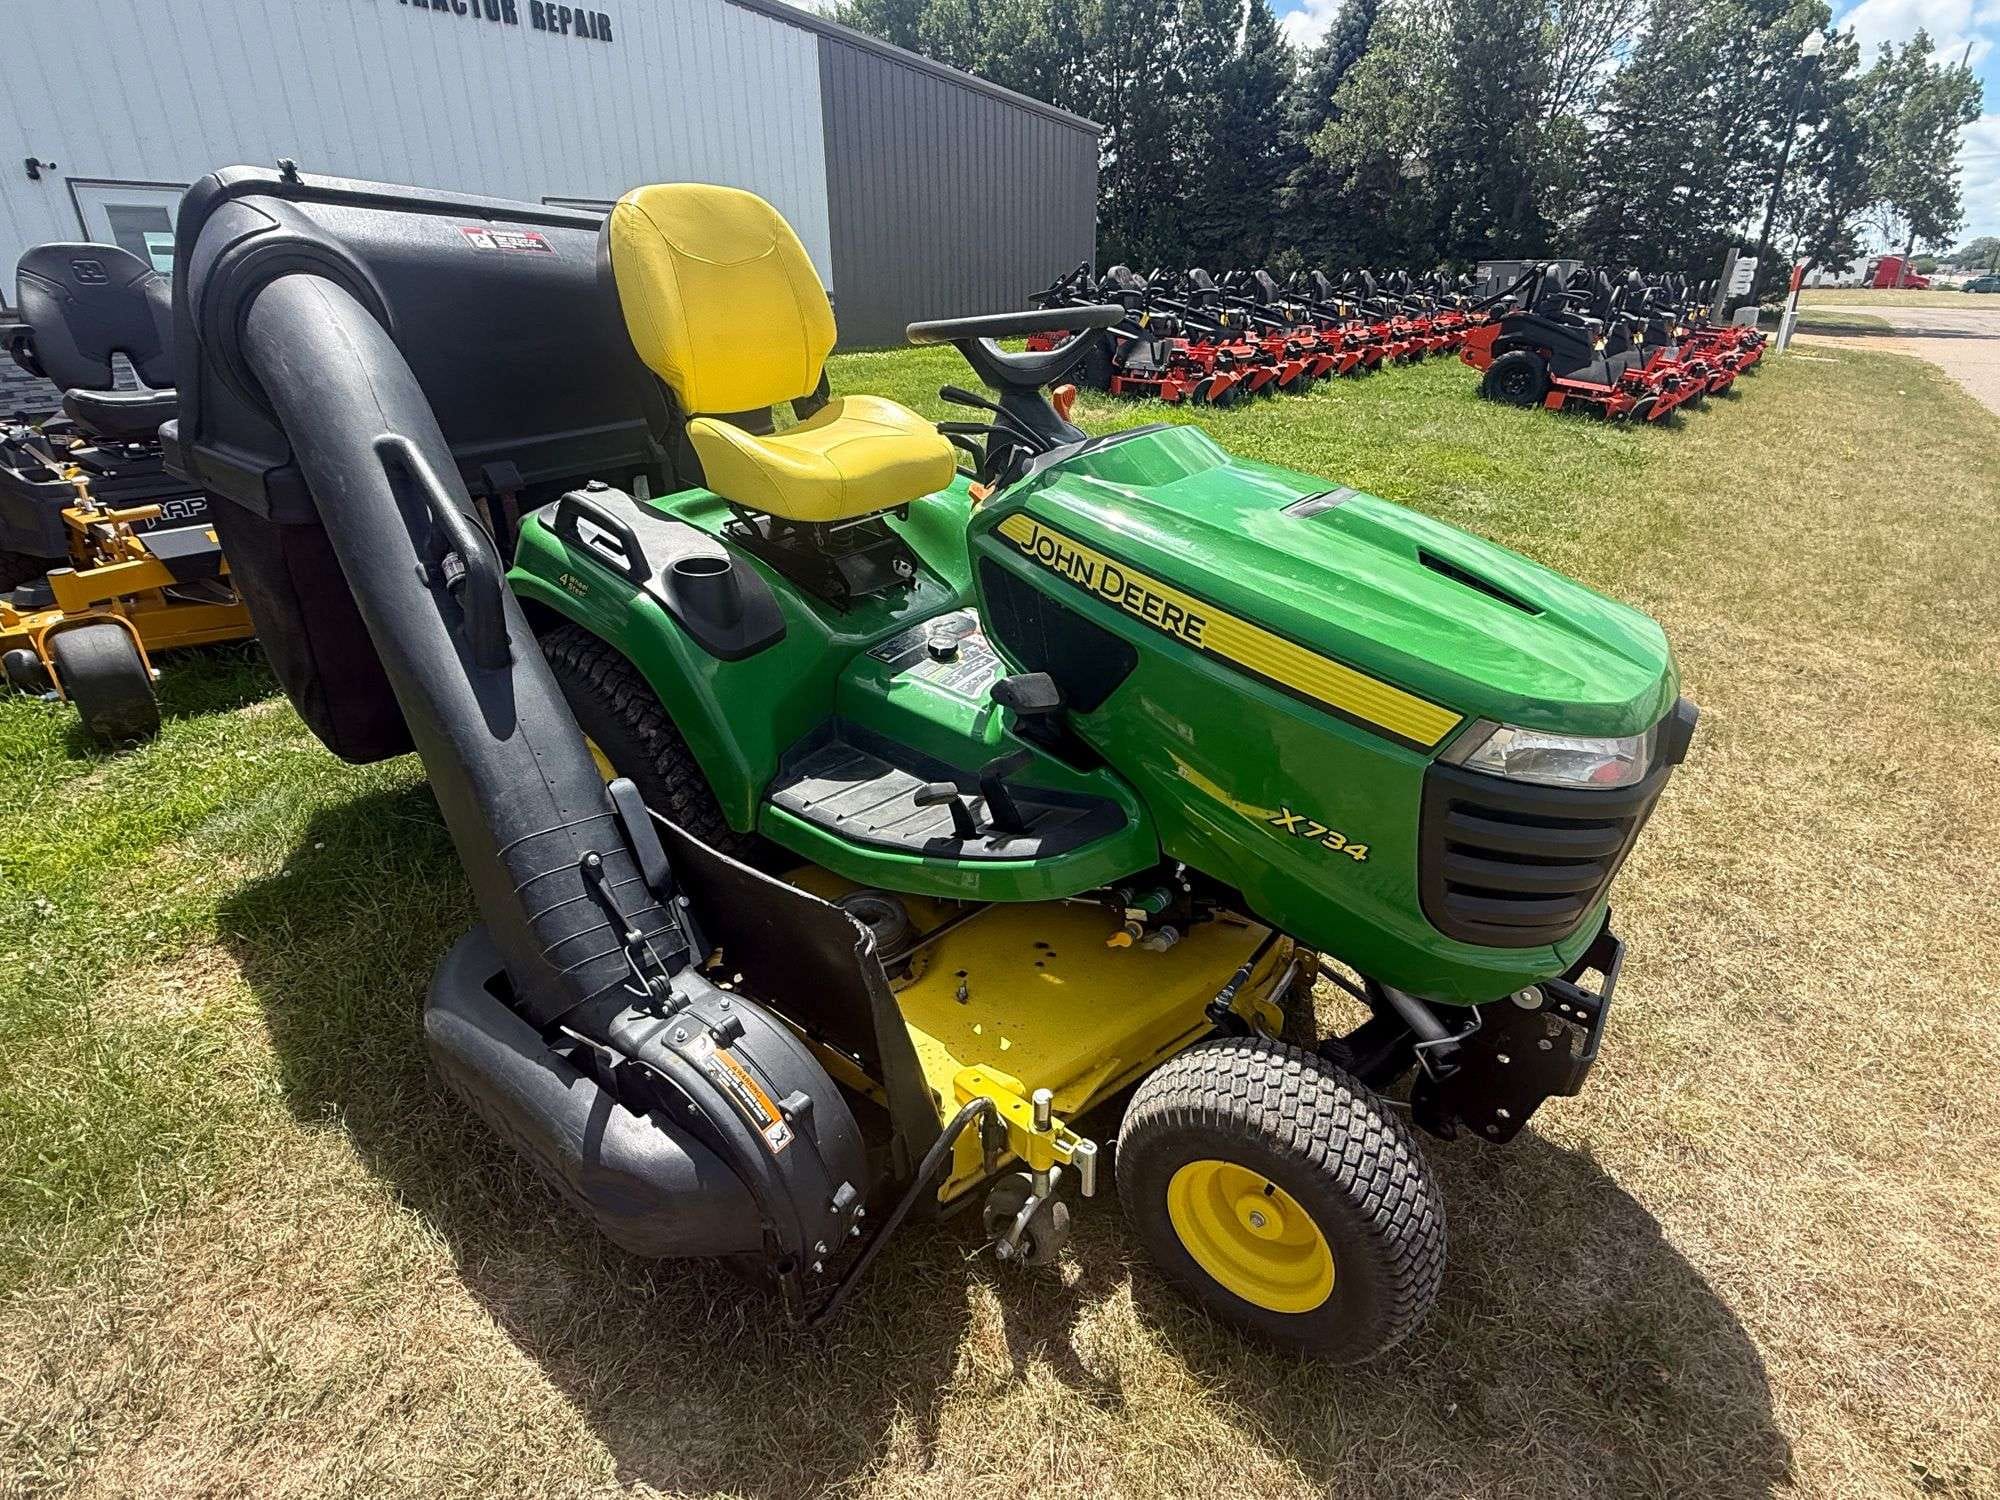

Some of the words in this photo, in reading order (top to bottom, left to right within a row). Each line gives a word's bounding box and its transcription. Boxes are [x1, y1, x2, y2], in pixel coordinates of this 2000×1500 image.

[530, 0, 613, 43] REPAIR
[560, 573, 569, 586] 4
[1020, 526, 1097, 587] JOHN
[1099, 563, 1207, 645] DEERE
[1268, 806, 1370, 861] X734
